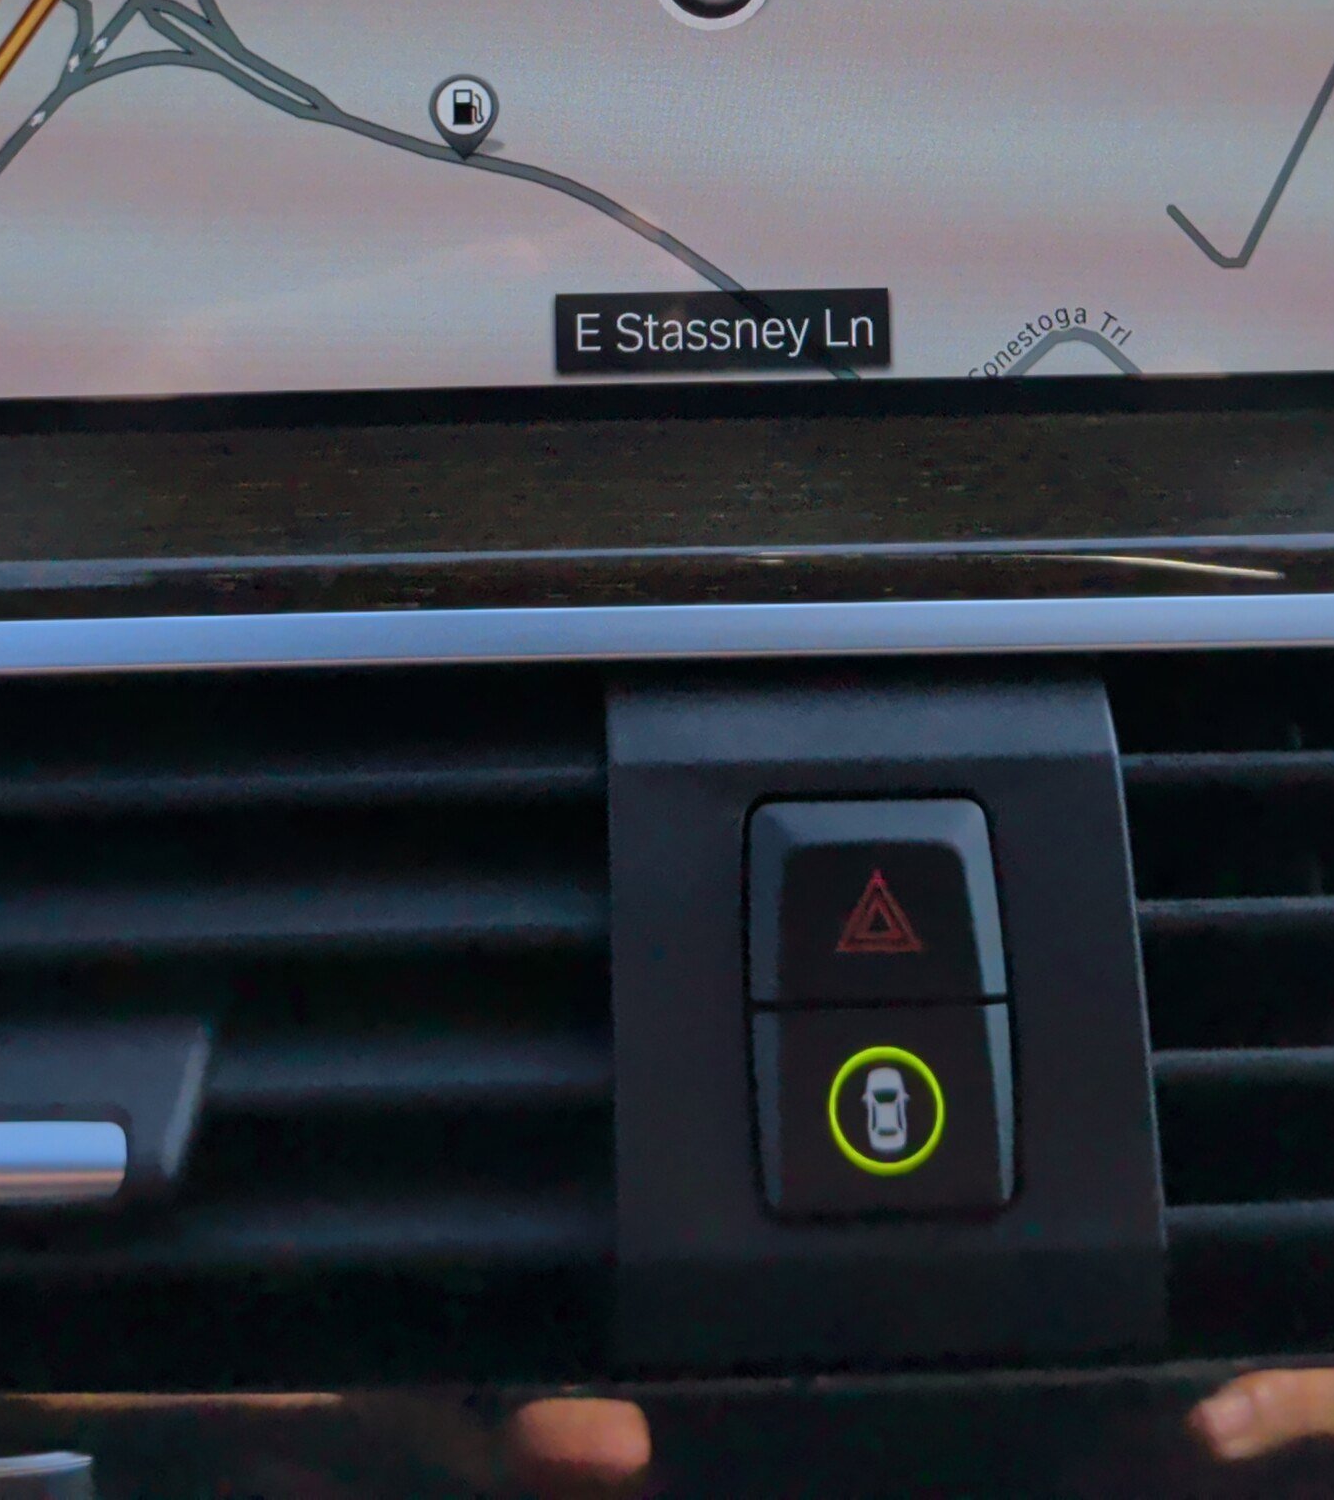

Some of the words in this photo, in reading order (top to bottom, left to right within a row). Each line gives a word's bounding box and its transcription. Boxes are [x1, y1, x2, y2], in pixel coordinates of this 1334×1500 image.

[576, 313, 602, 351] E
[616, 313, 810, 358] Stassney
[825, 308, 875, 348] Ln
[1100, 311, 1133, 346] Trl
